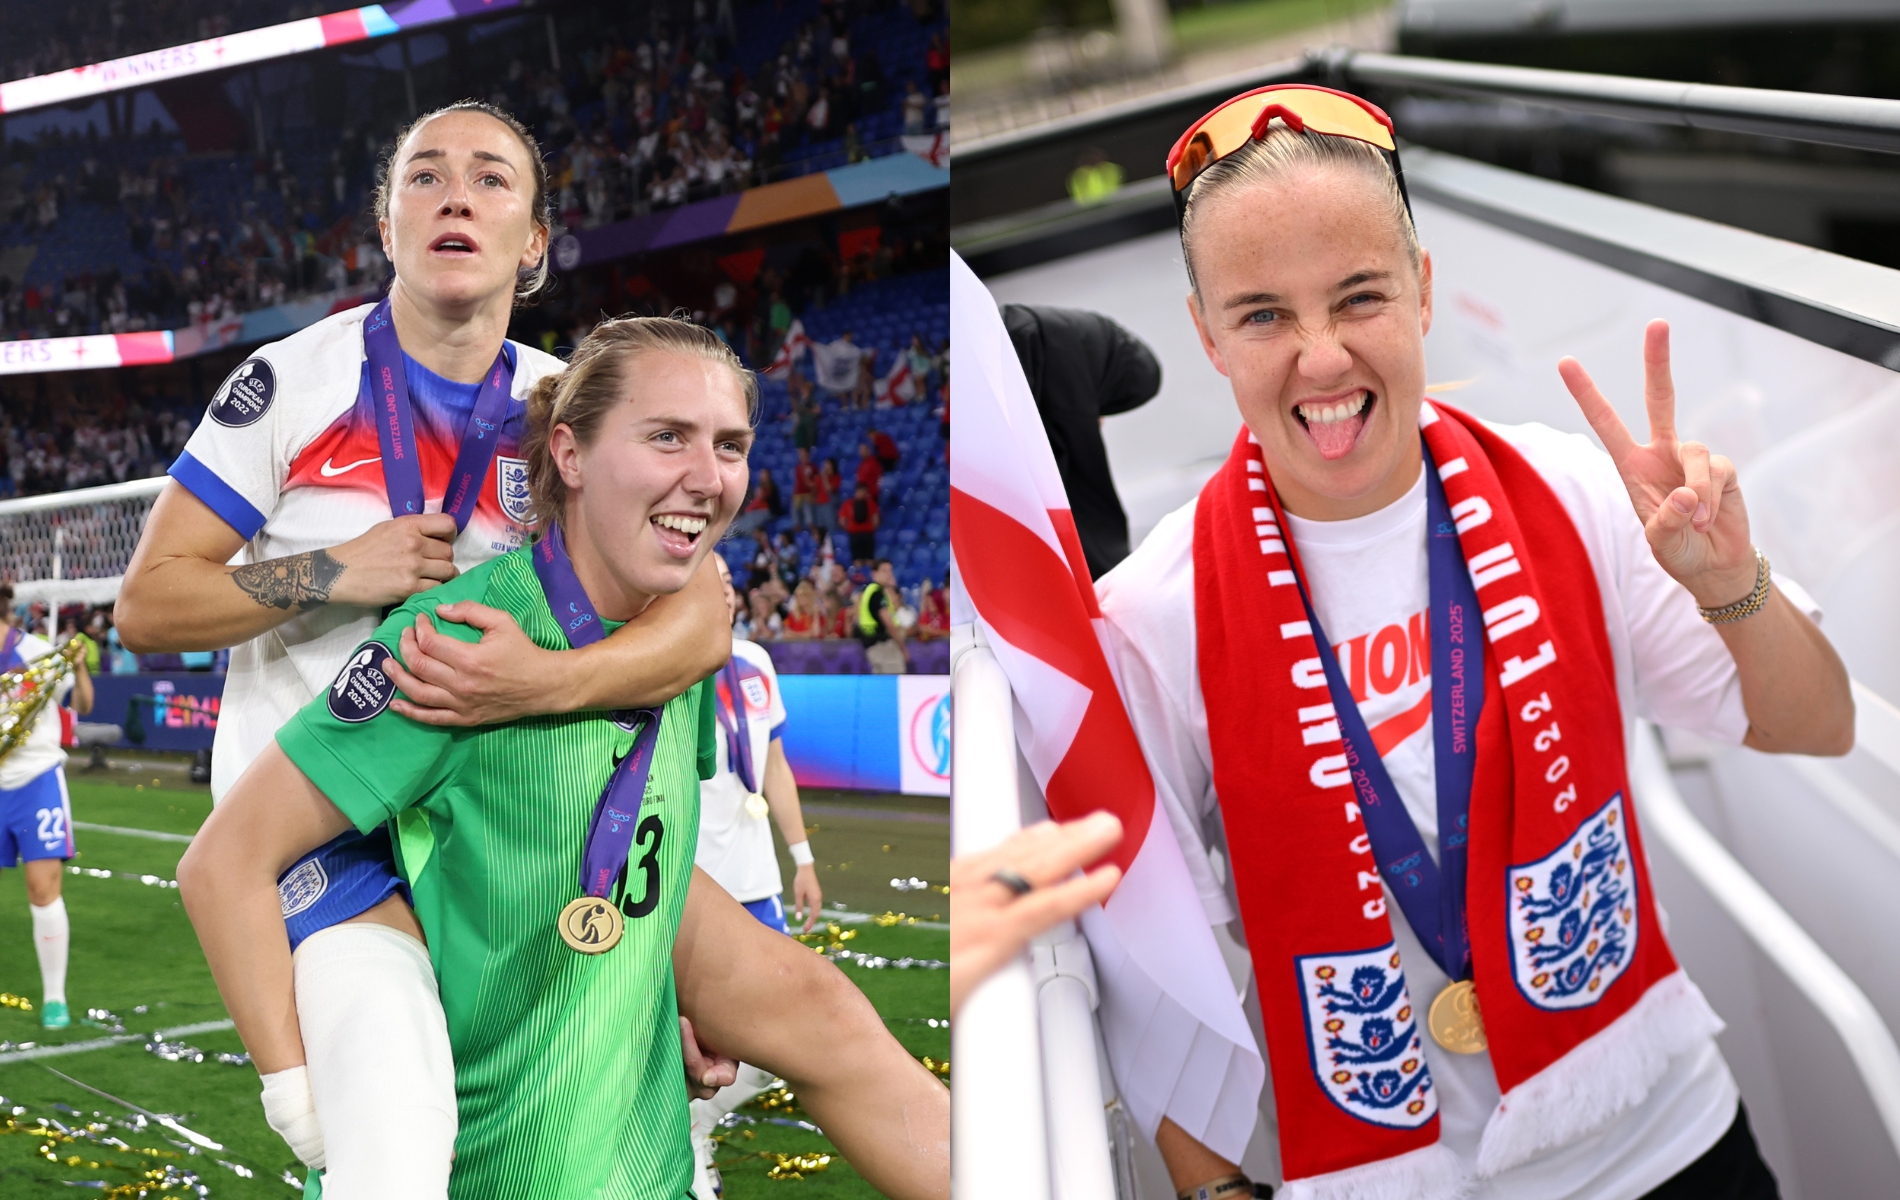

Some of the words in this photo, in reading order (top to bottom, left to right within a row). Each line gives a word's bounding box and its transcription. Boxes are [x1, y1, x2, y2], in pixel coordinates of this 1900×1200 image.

[237, 382, 265, 406] EUROPEAN
[381, 367, 394, 391] 2025
[230, 397, 250, 415] 2022
[232, 387, 261, 412] CHAMPIONS
[385, 393, 404, 460] SWITZERLAND
[1449, 604, 1464, 644] 2025
[1331, 607, 1432, 705] ION
[350, 676, 379, 708] CHAMPIONS
[355, 671, 383, 701] EUROPEAN
[367, 668, 385, 687] UEFA
[347, 688, 367, 710] 2022
[1452, 648, 1467, 754] SWITZERLAND
[1519, 690, 1577, 814] 2022
[1352, 769, 1379, 806] 2025
[36, 806, 66, 841] 22
